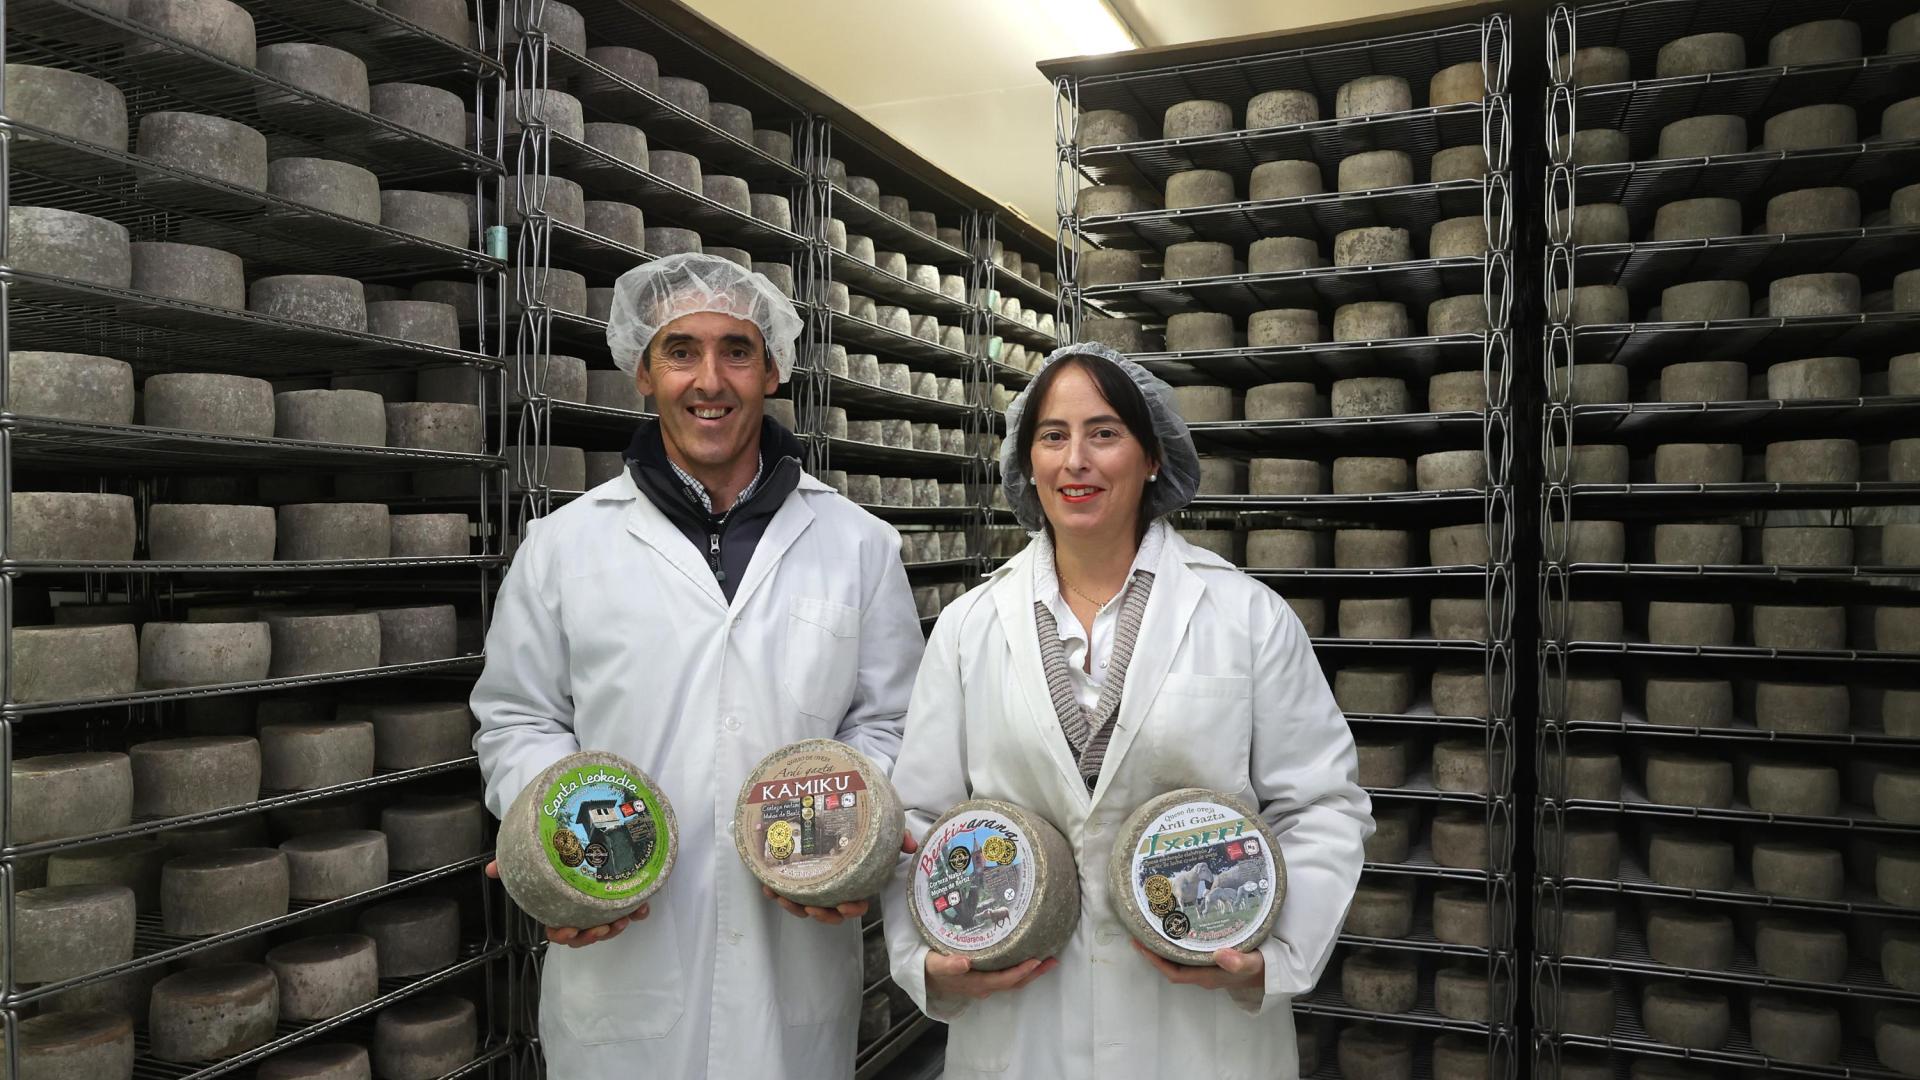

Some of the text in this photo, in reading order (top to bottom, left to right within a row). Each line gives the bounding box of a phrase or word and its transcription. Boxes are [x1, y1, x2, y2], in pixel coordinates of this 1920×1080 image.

[544, 783, 579, 818] Santa
[578, 770, 638, 794] Leokadia
[762, 775, 850, 800] KAMIKU
[1157, 812, 1225, 832] Ardi Gazta
[1164, 809, 1184, 822] Queso
[1196, 806, 1215, 814] oveja
[1143, 821, 1245, 859] Ixarri
